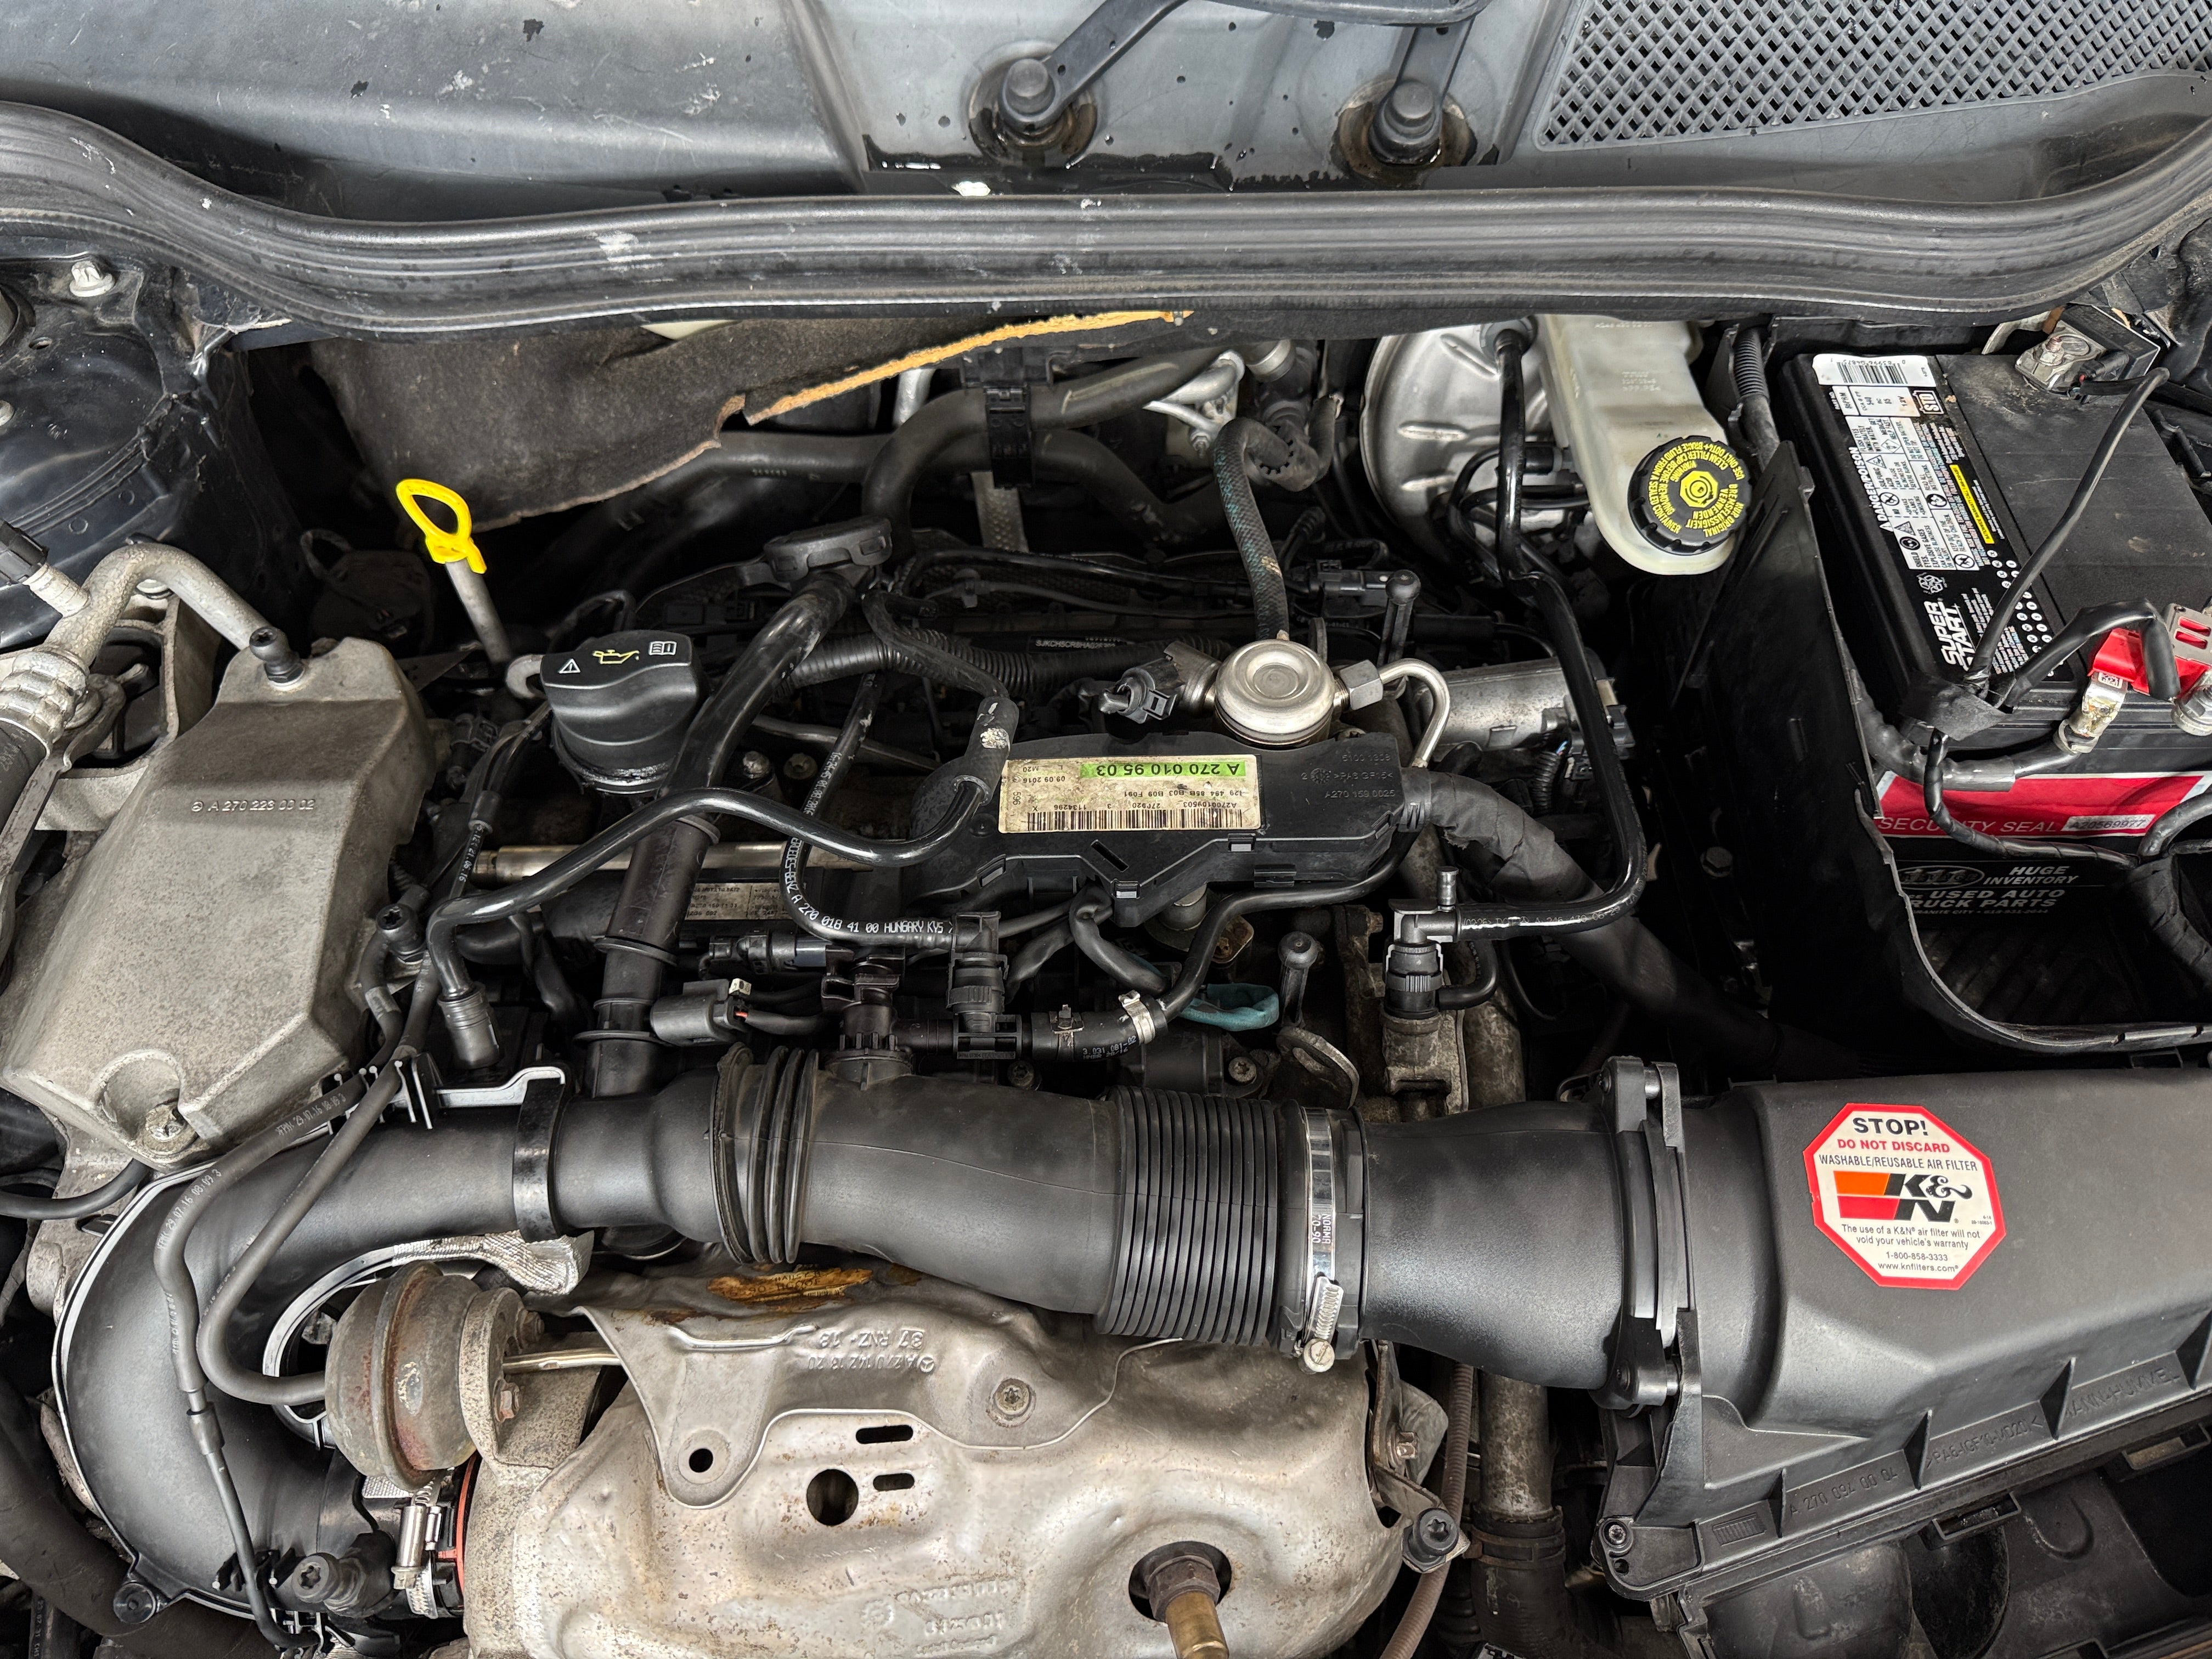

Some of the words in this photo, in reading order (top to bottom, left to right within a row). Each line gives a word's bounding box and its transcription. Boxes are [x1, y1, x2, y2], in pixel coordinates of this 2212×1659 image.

[1897, 396, 1908, 406] 12V
[1917, 393, 1940, 410] STD
[1875, 419, 1888, 435] MEDICAL
[1888, 430, 1897, 439] HELP
[1664, 445, 1682, 461] FLUID
[1682, 442, 1703, 450] BRAKE
[1872, 442, 1881, 451] WITH
[1676, 452, 1688, 464] CAP
[1687, 450, 1709, 459] FILLER
[1709, 452, 1728, 470] CLEAN
[1723, 453, 1738, 467] ONLY
[1654, 458, 1666, 474] FROM
[1660, 460, 1678, 483] BEFORE
[1669, 460, 1697, 482] WARNING
[1734, 468, 1745, 480] USE
[1847, 447, 1888, 521] DANGER/POISON
[1885, 478, 1894, 487] ACID
[1648, 481, 1658, 505] SEALED
[1658, 483, 1675, 516] REMOVING
[1692, 488, 1728, 520] VERWENDEN
[1730, 502, 1744, 518] NUR
[1652, 506, 1682, 534] CONTAINER
[1703, 518, 1735, 537] ORIGINAL
[1916, 529, 1929, 542] GASES
[1910, 552, 1923, 567] SHIELD
[1923, 544, 1940, 567] EXPLOSIVE
[1920, 601, 1964, 665] SUPER
[1096, 765, 1116, 776] 03
[1124, 764, 1144, 775] 95
[1151, 764, 1182, 775] 010
[1189, 764, 1220, 775] 270
[1227, 764, 1239, 775] A
[1373, 789, 1396, 798] 0025
[208, 800, 219, 811] A
[222, 800, 247, 811] 270
[1877, 817, 1996, 832] SECUITY
[2000, 821, 2059, 832] SEAL
[785, 837, 803, 894] ERCEDES-BENZ
[2008, 866, 2070, 876] HUGE
[1983, 875, 2079, 885] INVENTORY
[791, 894, 803, 904] A
[1929, 890, 1994, 899] USED
[2000, 889, 2066, 898] AUTO
[1909, 899, 1973, 908] RUCK
[1979, 899, 2058, 907] PARTS
[799, 903, 819, 921] 270
[822, 916, 843, 930] 018
[847, 922, 859, 932] 41
[865, 922, 879, 933] 00
[884, 921, 924, 933] HUNGARY
[1853, 1117, 1928, 1136] STOP!
[1837, 1139, 1856, 1149] DO
[1860, 1139, 1887, 1150] NOT
[1893, 1141, 1950, 1153] DISCARD
[1819, 1154, 1925, 1169] WASHABLE/REUSABLE
[1927, 1159, 1943, 1170] AIR
[1946, 1160, 1978, 1171] FILTER
[1312, 1214, 1322, 1244] 70-90
[1321, 1214, 1331, 1244] NORMA
[1841, 1224, 1858, 1233] The
[1876, 1226, 1884, 1234] of
[1918, 1228, 1928, 1236] air
[1930, 1228, 1948, 1237] filter
[1951, 1229, 1965, 1238] will
[1967, 1231, 1980, 1239] not
[1896, 1238, 1932, 1247] vehicle's
[1933, 1240, 1969, 1250] warranty
[1886, 1252, 1948, 1262] 1-800-858-3333
[1789, 1504, 1798, 1516] A
[1804, 1491, 1827, 1512] 270
